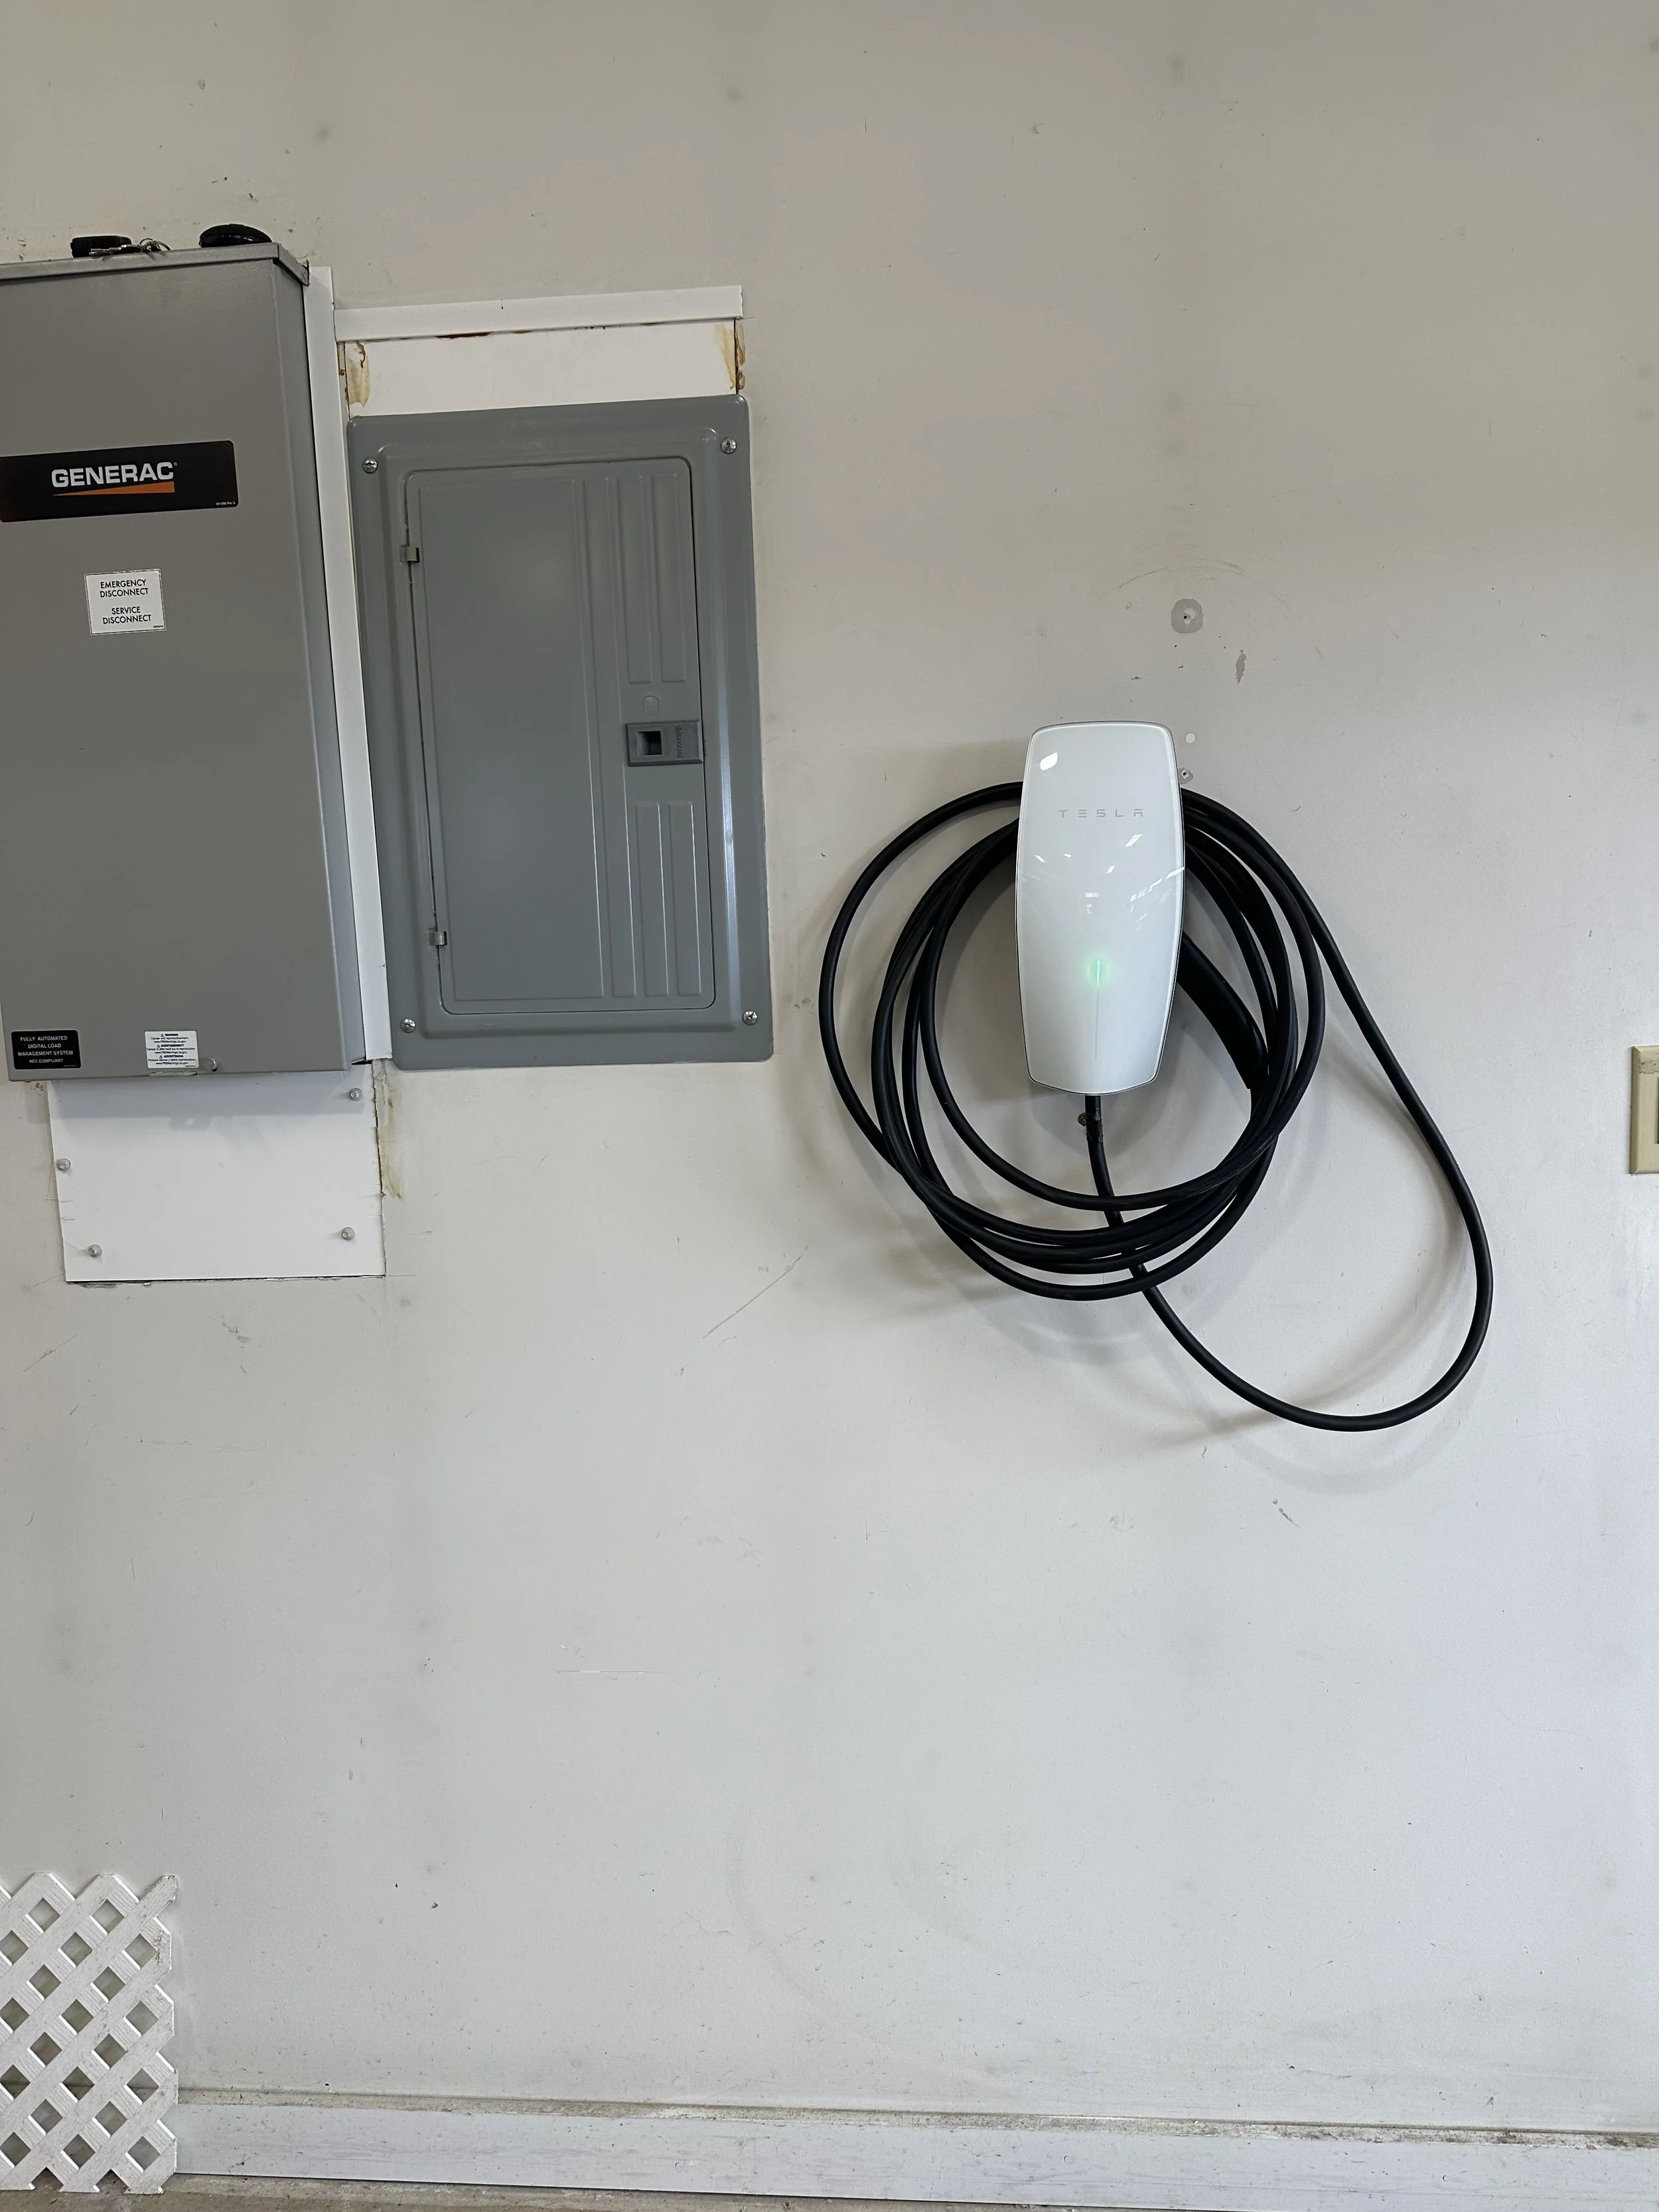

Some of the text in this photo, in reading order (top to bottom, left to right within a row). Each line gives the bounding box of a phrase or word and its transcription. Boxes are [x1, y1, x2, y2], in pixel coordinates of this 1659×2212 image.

[51, 461, 174, 488] GENERAC
[100, 579, 146, 589] EMERGENCY
[100, 588, 149, 597] DISCONNECT
[103, 615, 151, 625] DISCONNECT
[1057, 808, 1143, 818] TESLA
